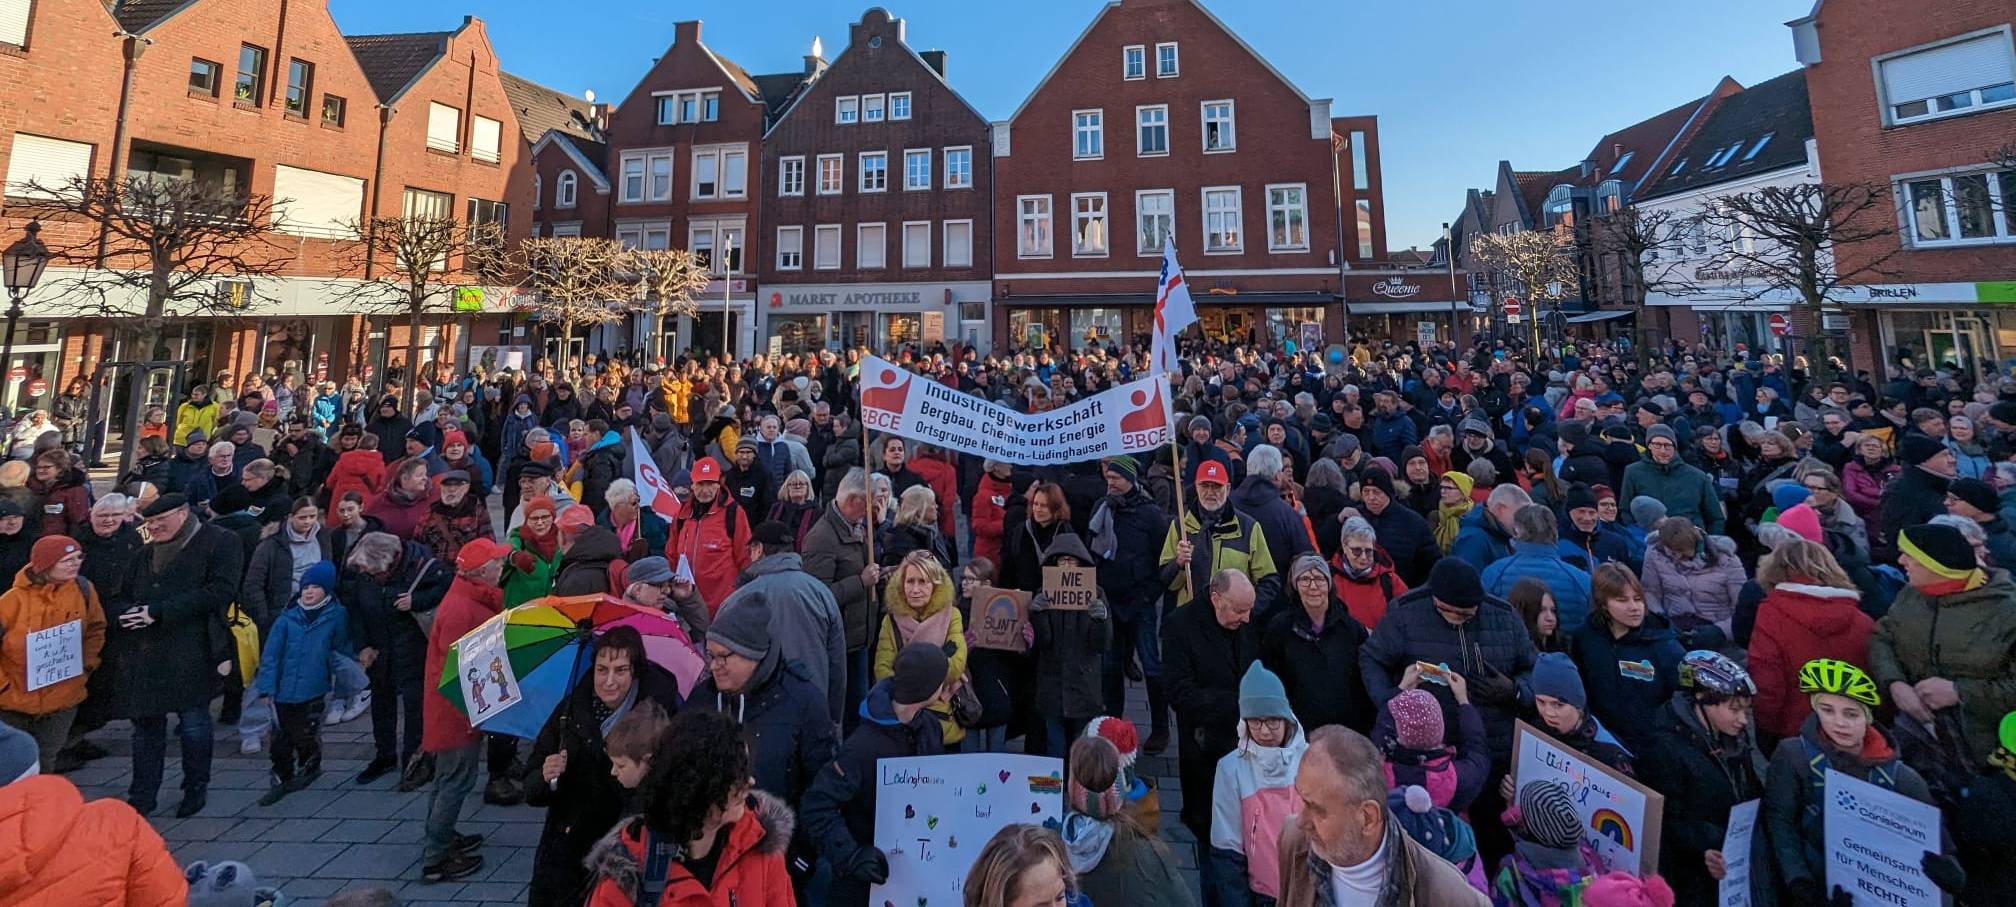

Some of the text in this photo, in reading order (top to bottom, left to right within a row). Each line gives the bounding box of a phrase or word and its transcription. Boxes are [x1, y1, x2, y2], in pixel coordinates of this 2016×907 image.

[789, 292, 920, 305] MARKT APOTHEKE
[1869, 288, 1917, 298] BRILLEN
[925, 382, 1104, 433] Industriegewerkschaft
[915, 420, 978, 449] Ortsgruppe
[982, 421, 1026, 446] Chemie
[1031, 435, 1055, 447] und
[1060, 422, 1106, 444] Energie
[1061, 571, 1083, 587] NIE
[1044, 589, 1093, 606] WIEDER
[35, 622, 76, 642] ALLES
[37, 665, 71, 686] LIEBE
[1859, 807, 1926, 841] Canisianum
[1842, 837, 1920, 878] Gemeinsam
[1835, 851, 1930, 898] für Menschen-
[1857, 876, 1909, 907] RECHTE
